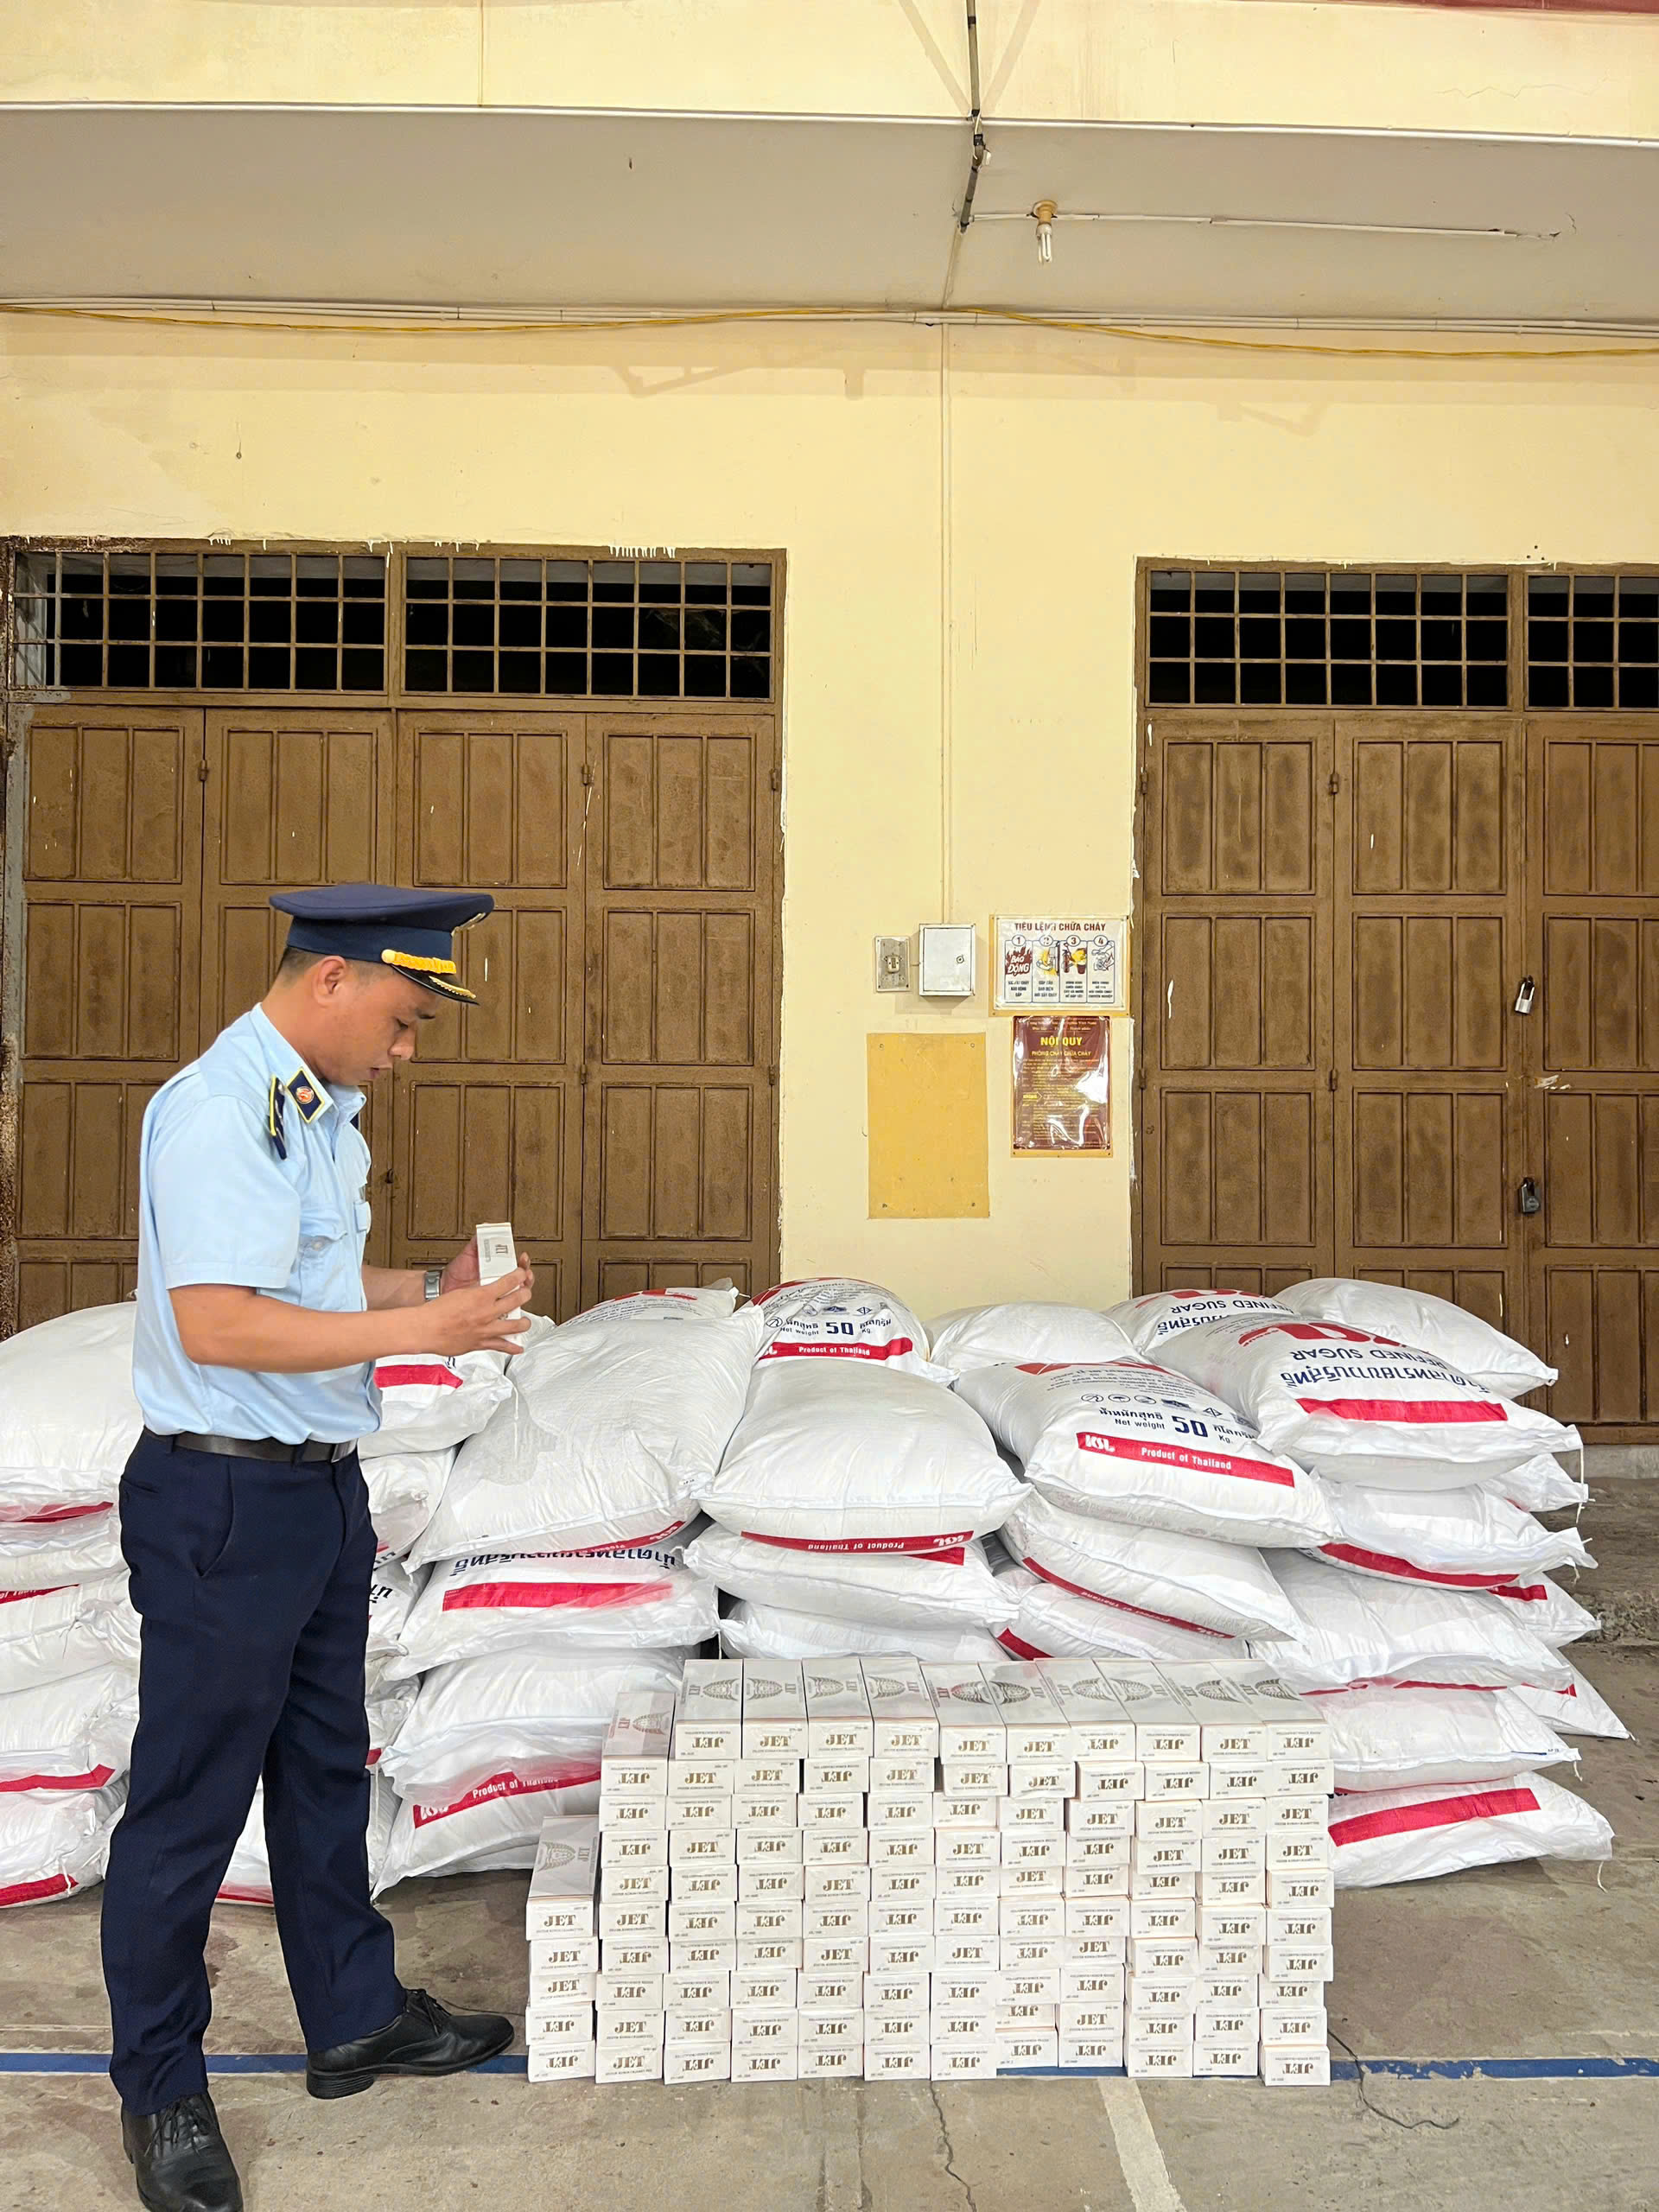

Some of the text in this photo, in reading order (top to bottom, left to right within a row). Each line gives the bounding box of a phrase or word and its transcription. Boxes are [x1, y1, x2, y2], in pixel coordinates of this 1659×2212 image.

[1171, 1300, 1226, 1314] SUGAR
[826, 1322, 854, 1335] 50
[840, 1347, 870, 1356] Thailand
[1290, 1348, 1363, 1361] SUGAR
[1115, 1418, 1165, 1430] Net weight
[1172, 1415, 1208, 1438] 50
[1084, 1435, 1231, 1471] KSL Product of Thailand
[692, 1737, 724, 1749] JET
[825, 1733, 857, 1745] JET
[1087, 1738, 1119, 1750] JET
[1153, 1738, 1185, 1750] JET
[1219, 1738, 1251, 1750] JET
[1283, 1737, 1314, 1749] JET
[618, 1772, 651, 1784] JET
[684, 1772, 716, 1784] JET
[821, 1770, 853, 1783] JET
[1226, 1776, 1257, 1788] JET
[1287, 1772, 1319, 1784] JET
[473, 1783, 505, 1798] Product
[509, 1780, 518, 1789] of
[1097, 1777, 1128, 1790] JET
[1162, 1777, 1194, 1789] JET
[616, 1808, 649, 1819] JET
[682, 1806, 715, 1818] JET
[748, 1805, 780, 1818] JET
[815, 1807, 847, 1819] JET
[885, 1806, 916, 1819] JET
[950, 1803, 981, 1815] JET
[1015, 1808, 1046, 1820] JET
[1281, 1808, 1313, 1820] JET
[1086, 1813, 1118, 1825] JET
[1218, 1813, 1249, 1825] JET
[619, 1843, 651, 1856] JET
[686, 1841, 718, 1853] JET
[753, 1840, 786, 1853] JET
[820, 1841, 852, 1853] JET
[887, 1843, 918, 1856] JET
[952, 1843, 984, 1855] JET
[1019, 1845, 1051, 1858] JET
[1083, 1843, 1115, 1856] JET
[1282, 1845, 1313, 1857] JET
[1153, 1849, 1184, 1862] JET
[1217, 1847, 1249, 1860] JET
[620, 1878, 652, 1890] JET
[688, 1878, 721, 1891] JET
[755, 1878, 788, 1891] JET
[823, 1878, 854, 1891] JET
[888, 1878, 920, 1891] JET
[953, 1875, 984, 1887] JET
[1083, 1873, 1114, 1885] JET
[1149, 1875, 1180, 1888] JET
[1218, 1881, 1249, 1893] JET
[1288, 1885, 1319, 1897] JET
[543, 1914, 576, 1927] JET
[616, 1913, 649, 1926] JET
[685, 1916, 718, 1929] JET
[753, 1915, 785, 1928] JET
[819, 1914, 851, 1927] JET
[886, 1913, 918, 1926] JET
[950, 1912, 982, 1924] JET
[1082, 1914, 1114, 1926] JET
[1147, 1915, 1179, 1927] JET
[1218, 1923, 1250, 1935] JET
[1284, 1923, 1316, 1935] JET
[754, 1946, 786, 1959] JET
[951, 1947, 983, 1959] JET
[1079, 1941, 1110, 1953] JET
[548, 1950, 581, 1963] JET
[619, 1951, 652, 1964] JET
[687, 1949, 720, 1961] JET
[820, 1948, 853, 1961] JET
[887, 1951, 919, 1964] JET
[1216, 1952, 1247, 1964] JET
[1153, 1955, 1185, 1967] JET
[1286, 1959, 1318, 1971] JET
[547, 1979, 580, 1993] JET
[747, 1985, 779, 1998] JET
[815, 1985, 847, 1997] JET
[1013, 1982, 1045, 1994] JET
[1077, 1980, 1108, 1992] JET
[1211, 1985, 1243, 1997] JET
[1276, 1986, 1308, 1998] JET
[613, 1986, 646, 1999] JET
[680, 1986, 713, 1999] JET
[880, 1988, 913, 2000] JET
[948, 1986, 980, 1999] JET
[1148, 1991, 1180, 2003] JET
[1077, 2013, 1108, 2025] JET
[1212, 2019, 1244, 2031] JET
[543, 2020, 575, 2033] JET
[614, 2021, 647, 2034] JET
[749, 2024, 782, 2037] JET
[815, 2023, 848, 2035] JET
[881, 2021, 913, 2034] JET
[947, 2021, 979, 2033] JET
[1146, 2023, 1178, 2034] JET
[1280, 2022, 1311, 2034] JET
[1011, 2044, 1042, 2056] JET
[1075, 2045, 1107, 2056] JET
[545, 2055, 579, 2069] JET
[613, 2056, 645, 2069] JET
[682, 2057, 715, 2072] JET
[748, 2058, 781, 2070] JET
[815, 2054, 847, 2067] JET
[881, 2056, 913, 2069] JET
[949, 2056, 981, 2069] JET
[1145, 2055, 1177, 2066] JET
[1210, 2053, 1242, 2064] JET
[1282, 2063, 1314, 2075] JET
